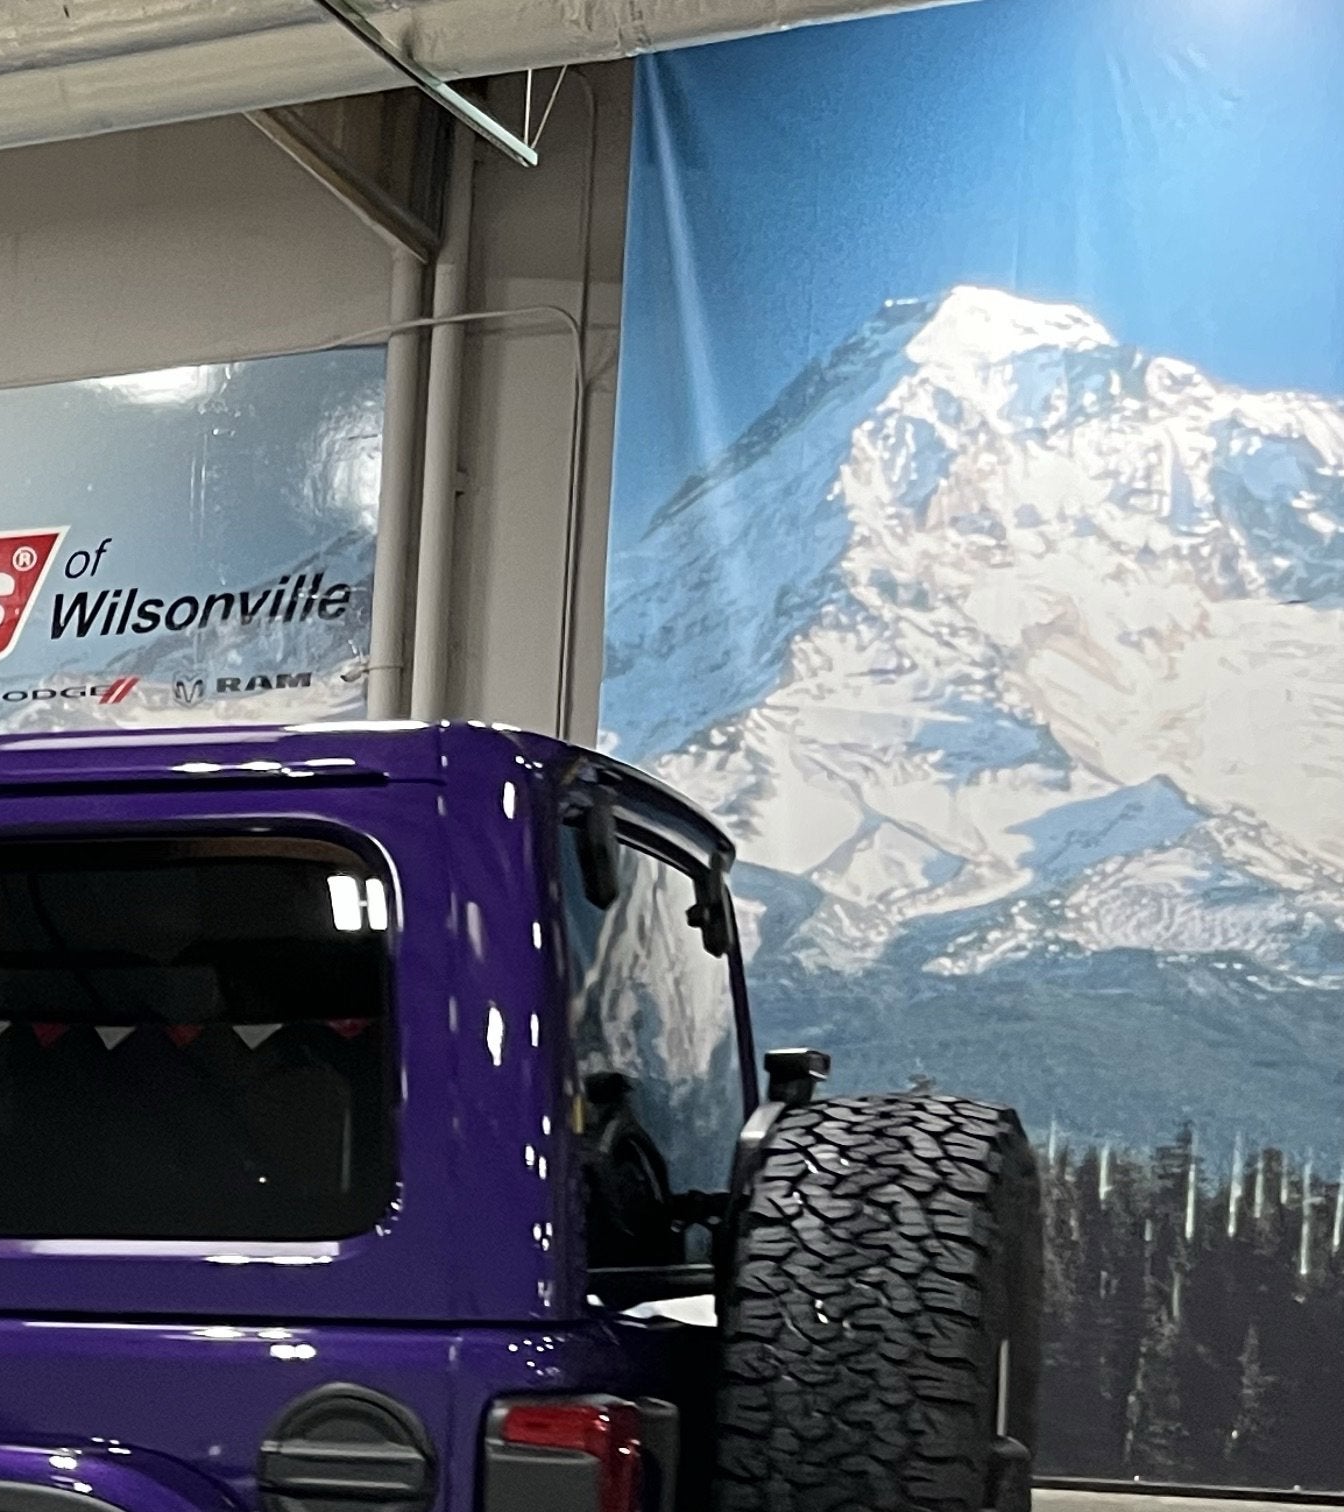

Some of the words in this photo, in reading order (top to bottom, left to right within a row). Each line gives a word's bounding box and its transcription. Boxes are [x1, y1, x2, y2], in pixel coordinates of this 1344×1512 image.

[64, 538, 112, 579] of
[50, 572, 352, 640] Wilsonville
[216, 671, 312, 693] RAM
